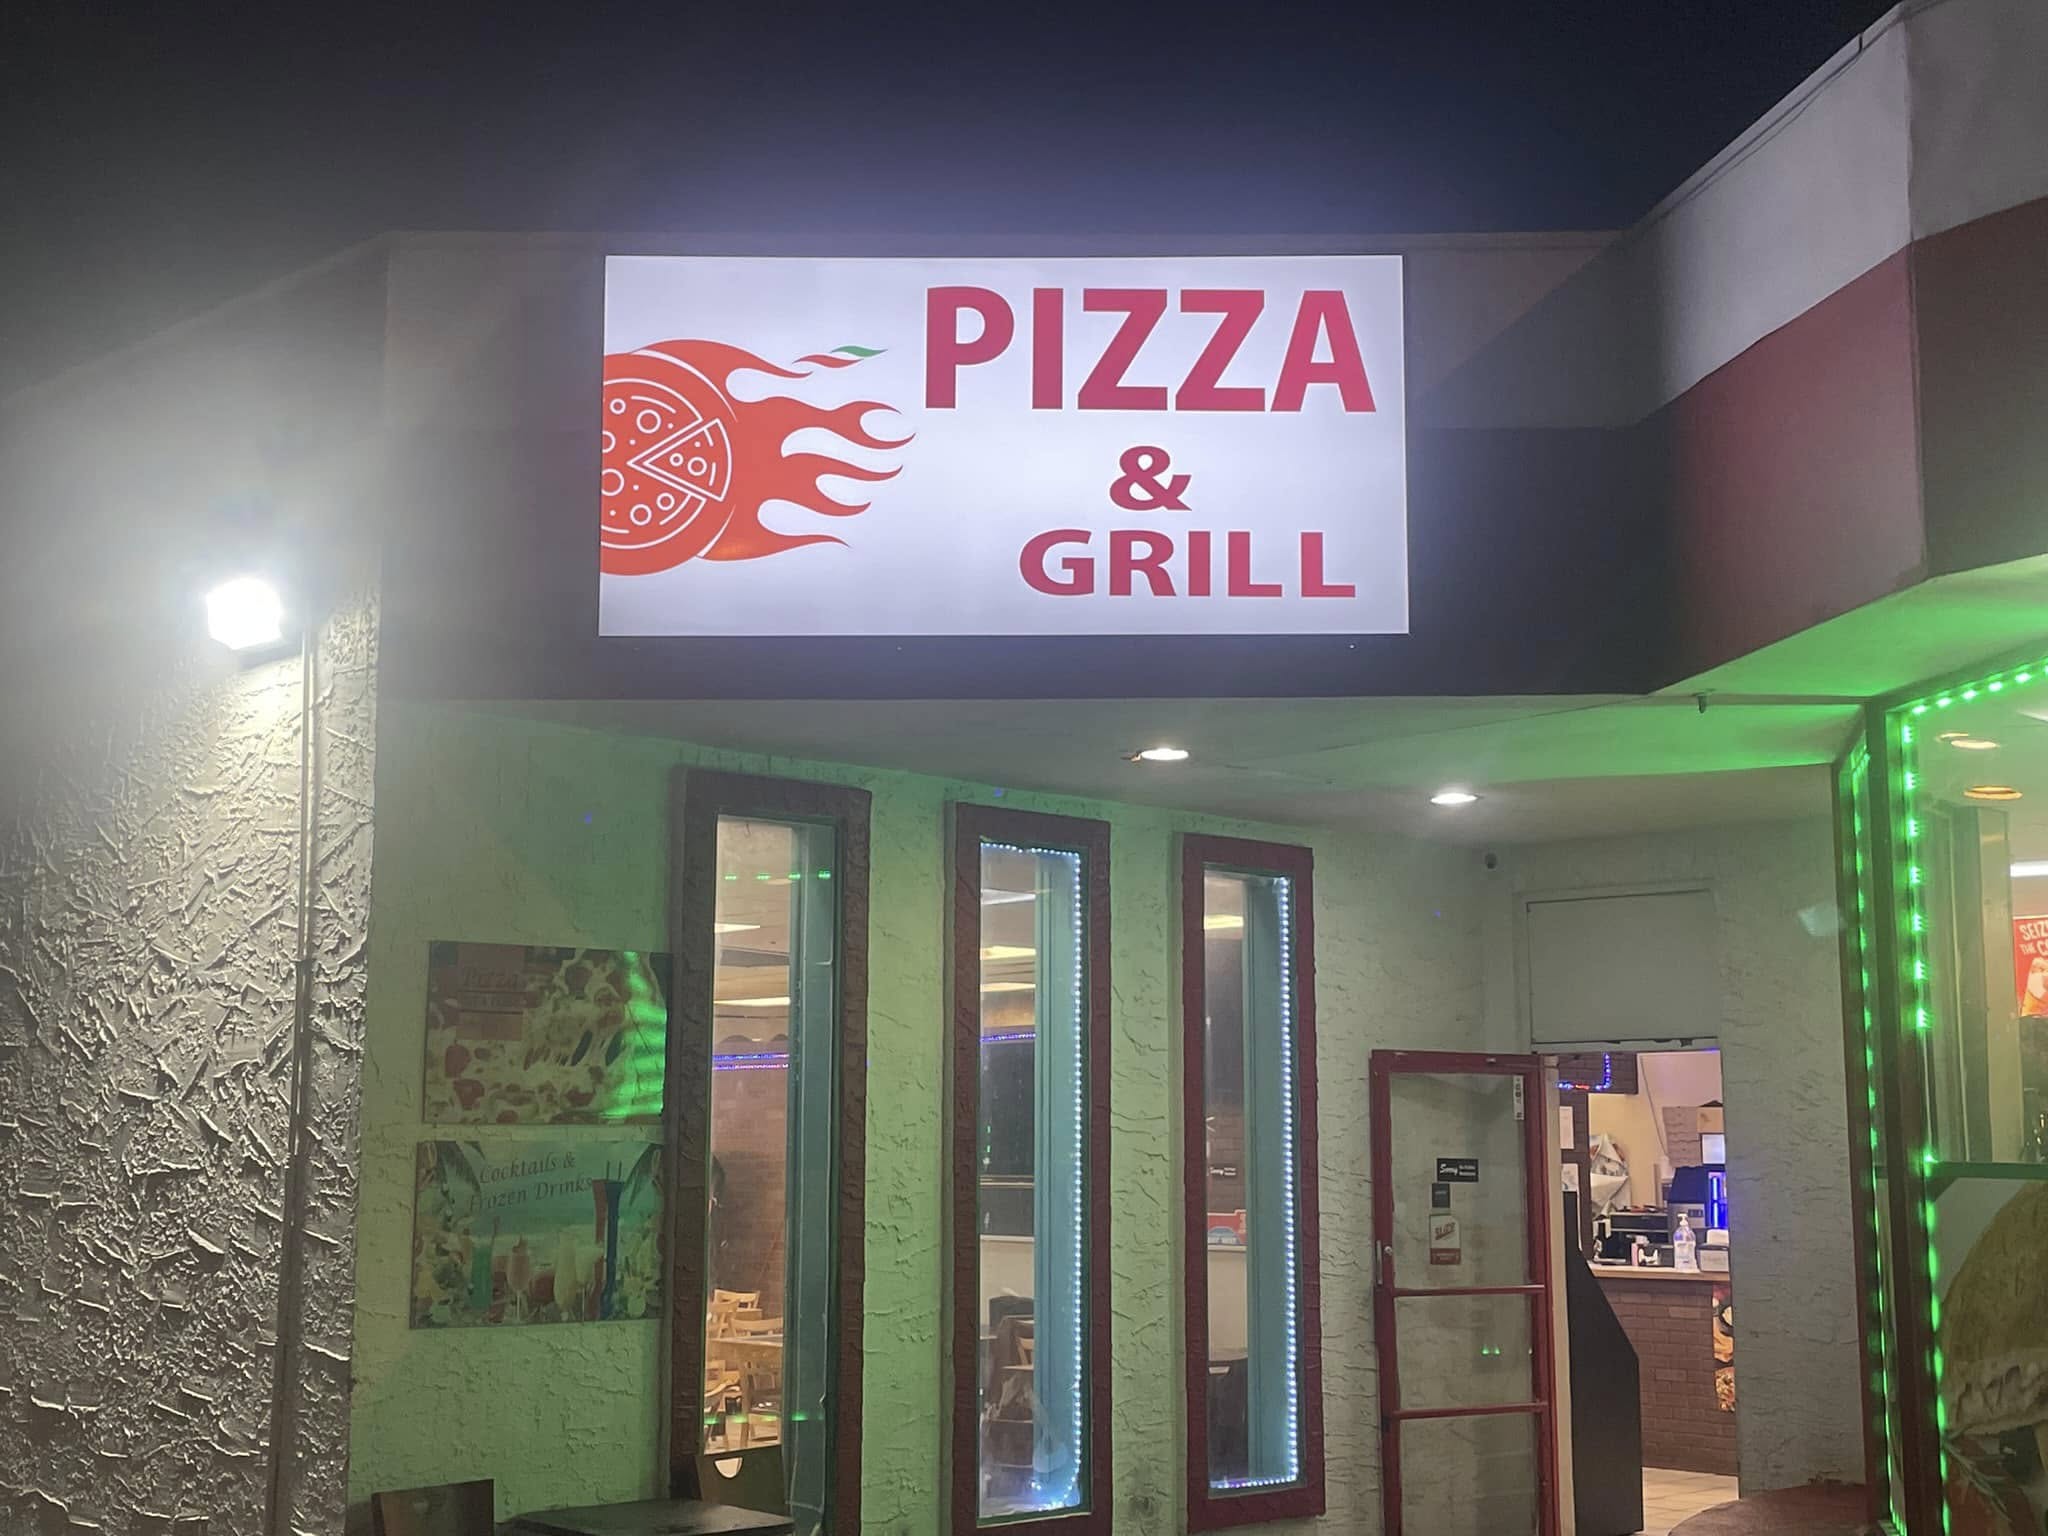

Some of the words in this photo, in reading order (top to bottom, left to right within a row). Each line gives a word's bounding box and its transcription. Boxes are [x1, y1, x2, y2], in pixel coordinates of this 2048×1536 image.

[925, 286, 1377, 413] PIZZA
[1109, 445, 1192, 511] &
[1019, 529, 1356, 598] GRILL
[2018, 921, 2048, 941] SEIZ
[480, 1152, 558, 1184] Cocktails
[563, 1151, 577, 1170] &
[535, 1175, 594, 1201] Drinks
